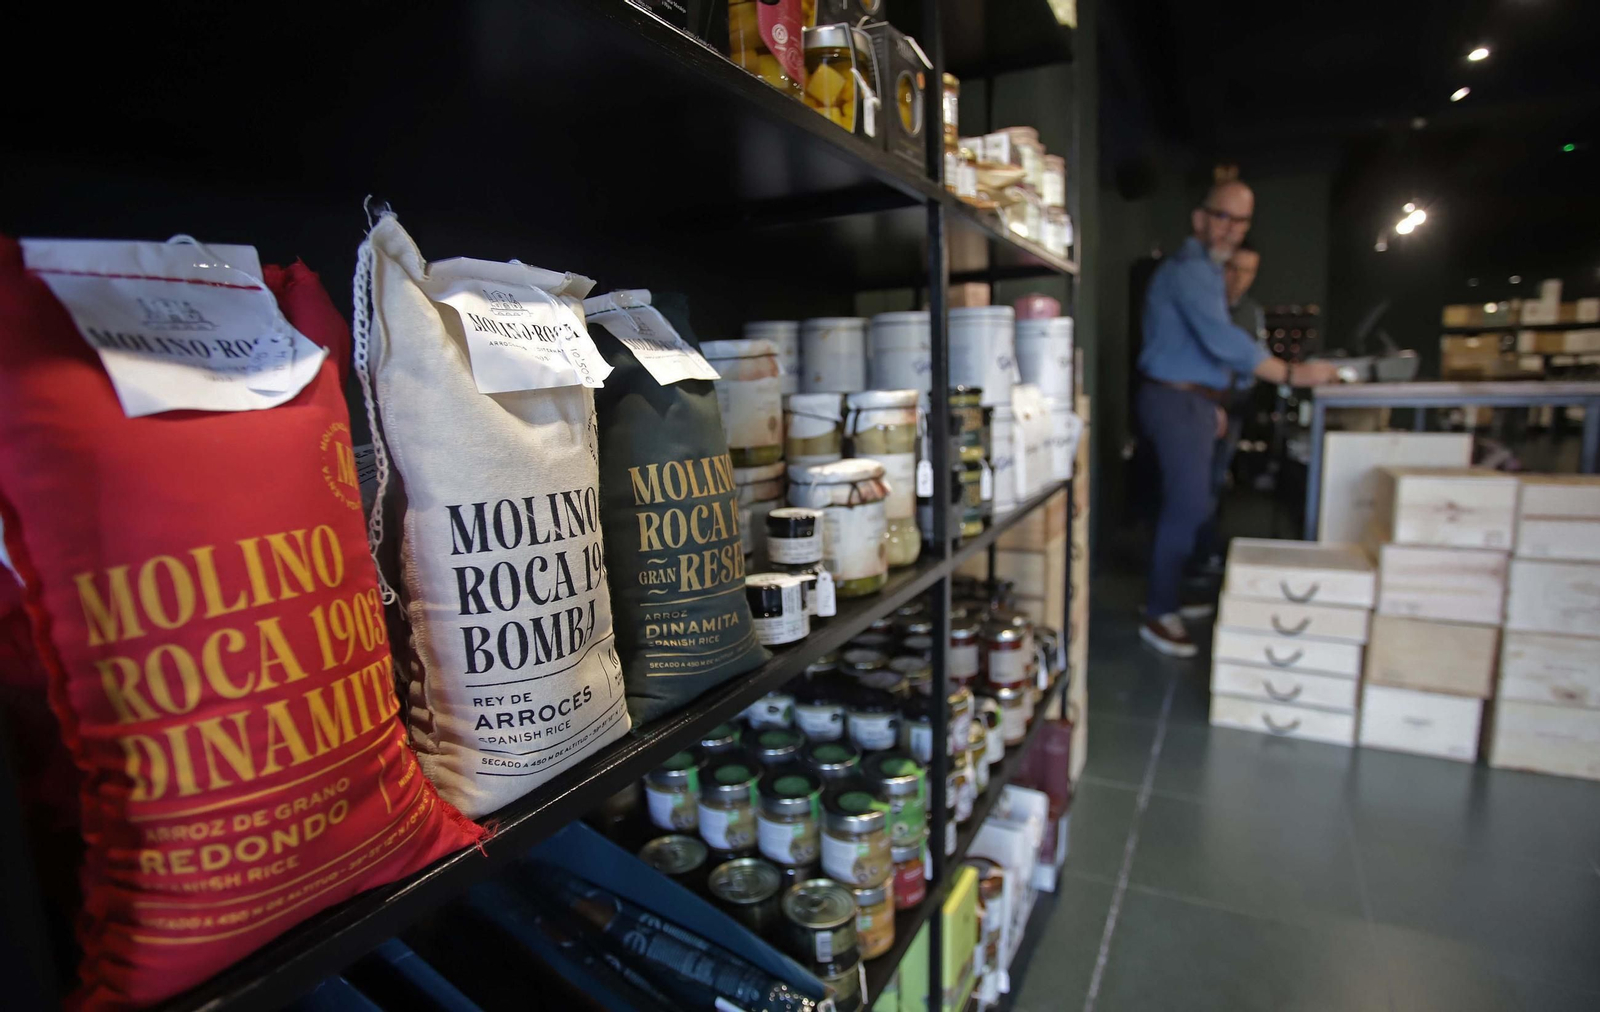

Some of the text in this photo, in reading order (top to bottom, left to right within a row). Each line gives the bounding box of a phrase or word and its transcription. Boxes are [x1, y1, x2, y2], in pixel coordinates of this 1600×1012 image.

[445, 486, 599, 555] MOLINO
[636, 501, 729, 552] ROCA
[74, 525, 344, 647] MOLINO
[452, 550, 578, 616] ROCA
[638, 567, 676, 585] GRAN
[459, 600, 597, 675] BOMBA
[645, 610, 688, 621] ARROZ
[646, 611, 739, 639] DINAMITA
[96, 587, 385, 725] ROCA 1903
[699, 635, 720, 645] RICE
[473, 692, 533, 707] REY DE
[474, 685, 592, 731] ARROCES
[120, 655, 401, 801] DINAMITA
[545, 719, 572, 736] RICE
[481, 757, 521, 769] SECADO
[530, 757, 547, 766] 450
[555, 749, 564, 759] DE
[233, 809, 270, 832] DE
[274, 777, 349, 820] GRANO
[139, 799, 348, 876] REDONDO
[247, 853, 300, 882] RICE
